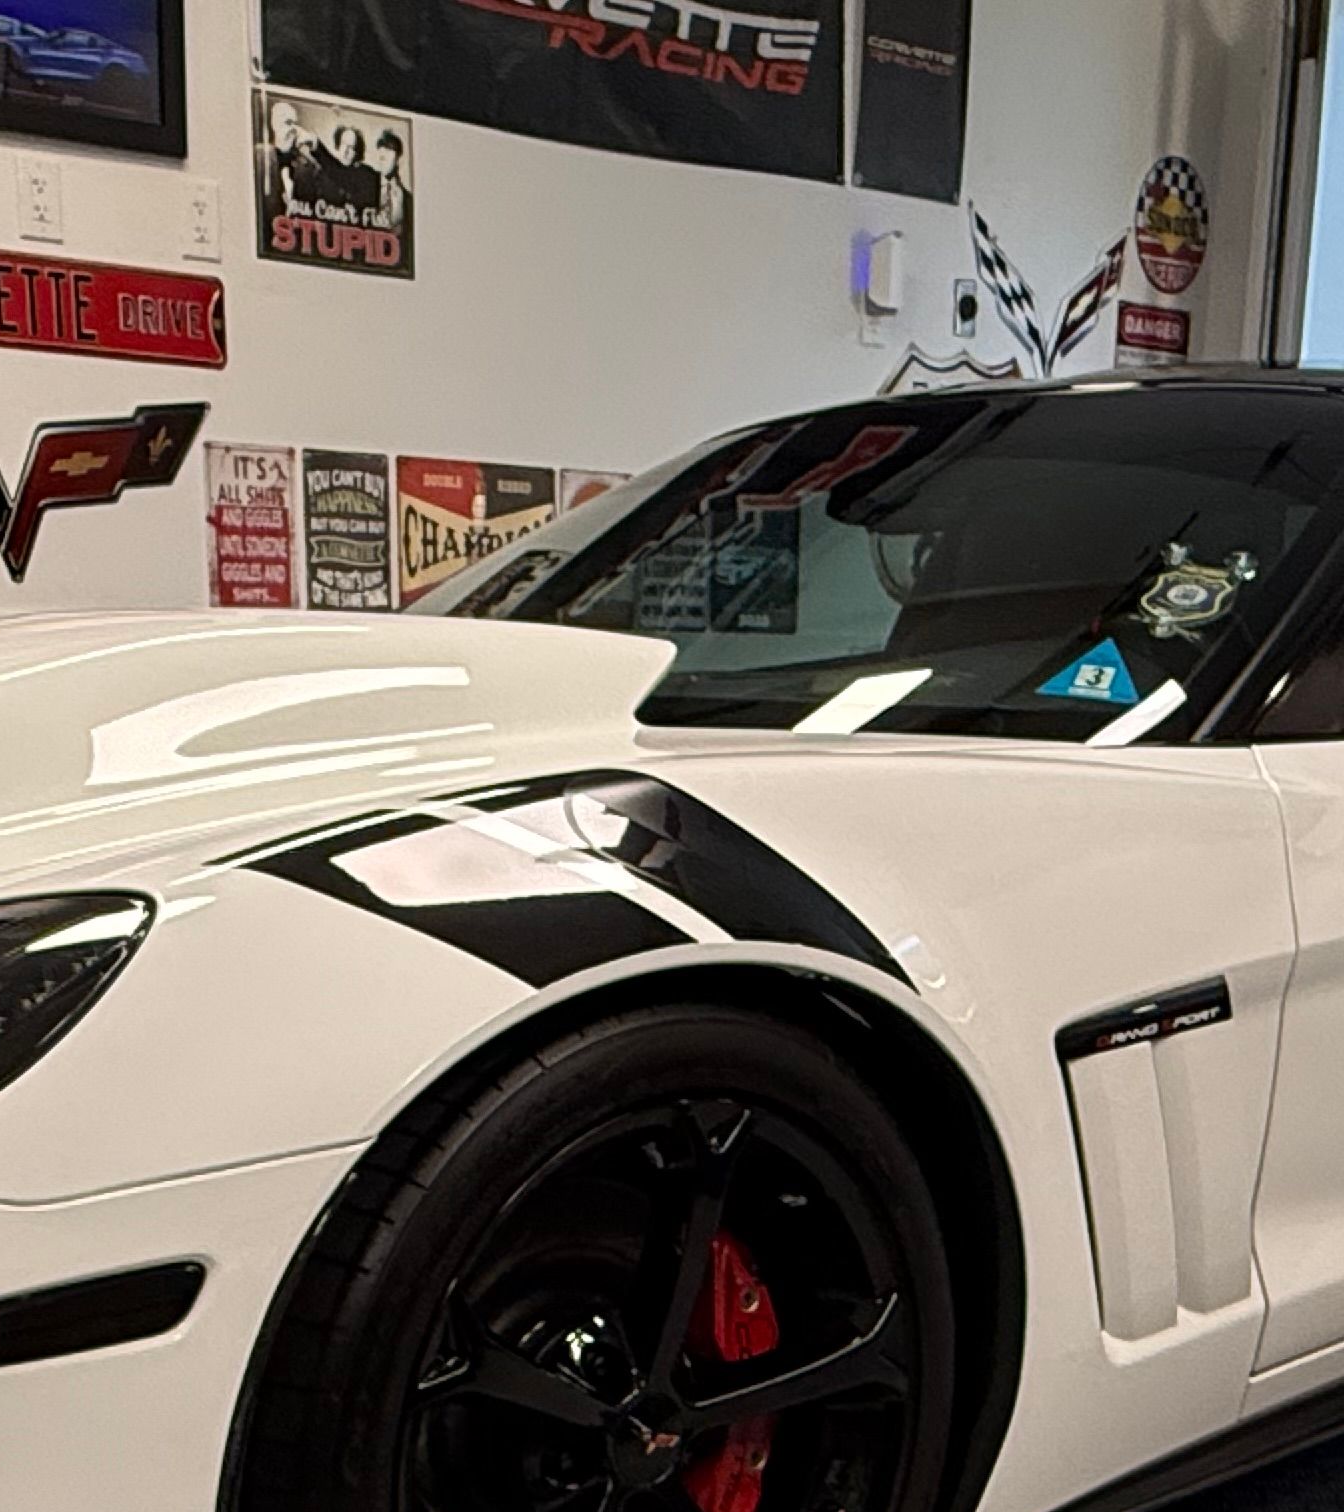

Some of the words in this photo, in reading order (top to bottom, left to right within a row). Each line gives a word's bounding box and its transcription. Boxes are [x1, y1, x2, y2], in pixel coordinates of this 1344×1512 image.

[546, 16, 808, 95] RACING
[315, 198, 358, 224] Can't
[272, 215, 401, 266] STUPID
[117, 291, 205, 341] DRIVE
[1124, 314, 1182, 340] DANGER
[233, 456, 267, 481] IT'S
[217, 483, 242, 505] ALL
[306, 470, 330, 496] YOU
[332, 469, 364, 490] CAN'T
[364, 472, 386, 500] BUY
[1085, 667, 1104, 685] 3
